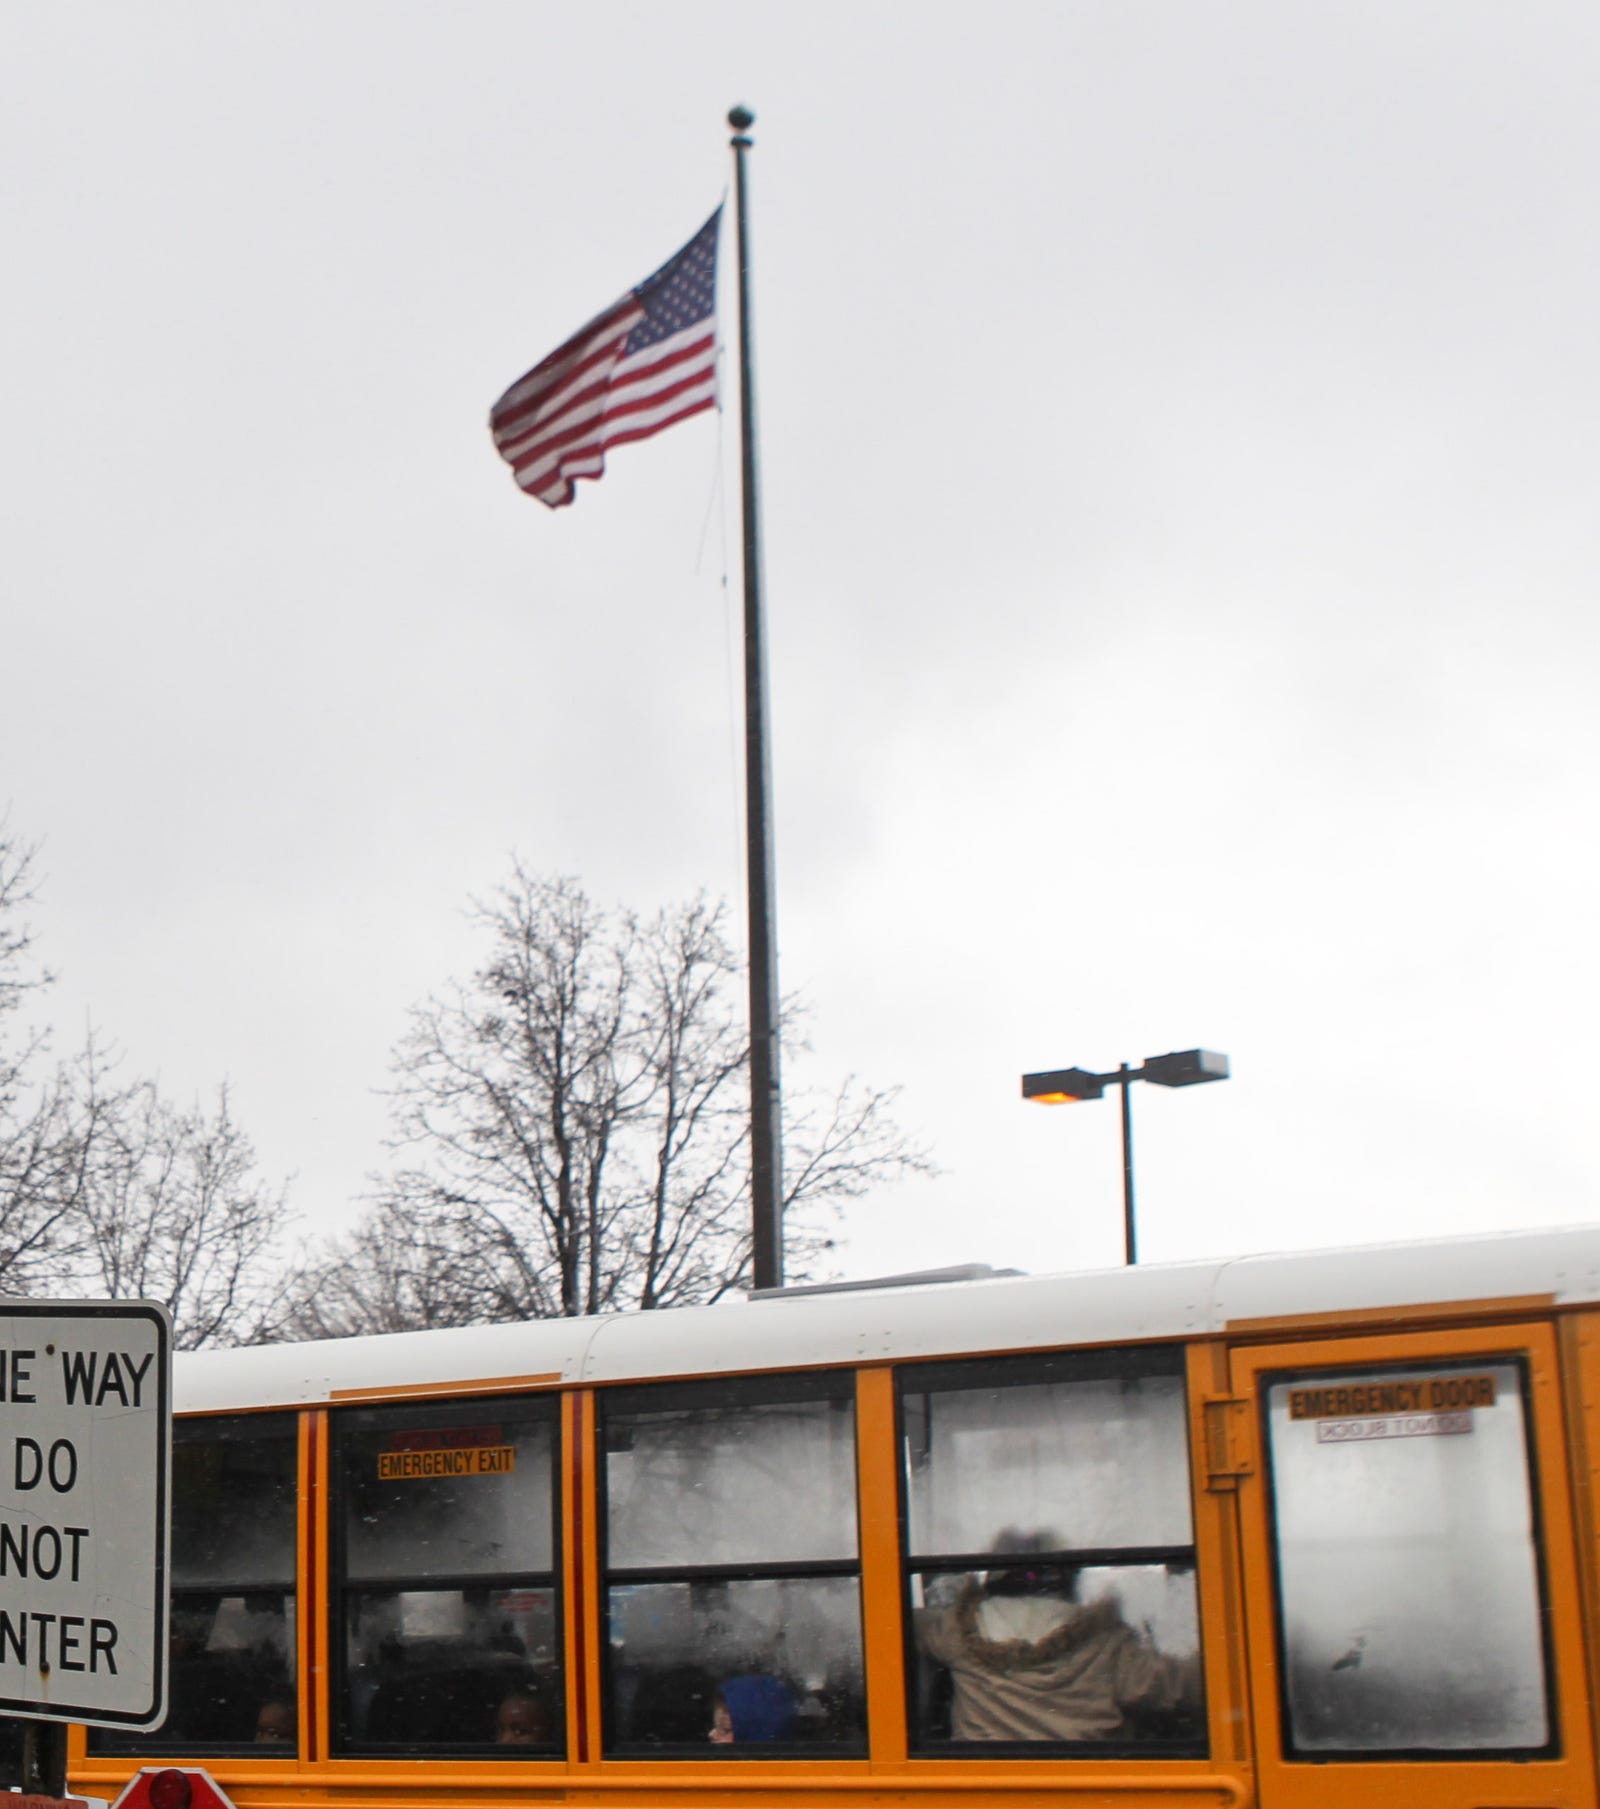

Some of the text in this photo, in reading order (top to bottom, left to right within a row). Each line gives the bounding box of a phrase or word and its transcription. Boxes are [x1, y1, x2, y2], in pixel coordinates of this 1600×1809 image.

[62, 1350, 154, 1408] WAY
[1292, 1378, 1492, 1417] EMERGENCY DOOR
[14, 1436, 78, 1493] DO
[380, 1449, 511, 1477] EMERGENCY EXIT
[0, 1522, 89, 1582] NOT
